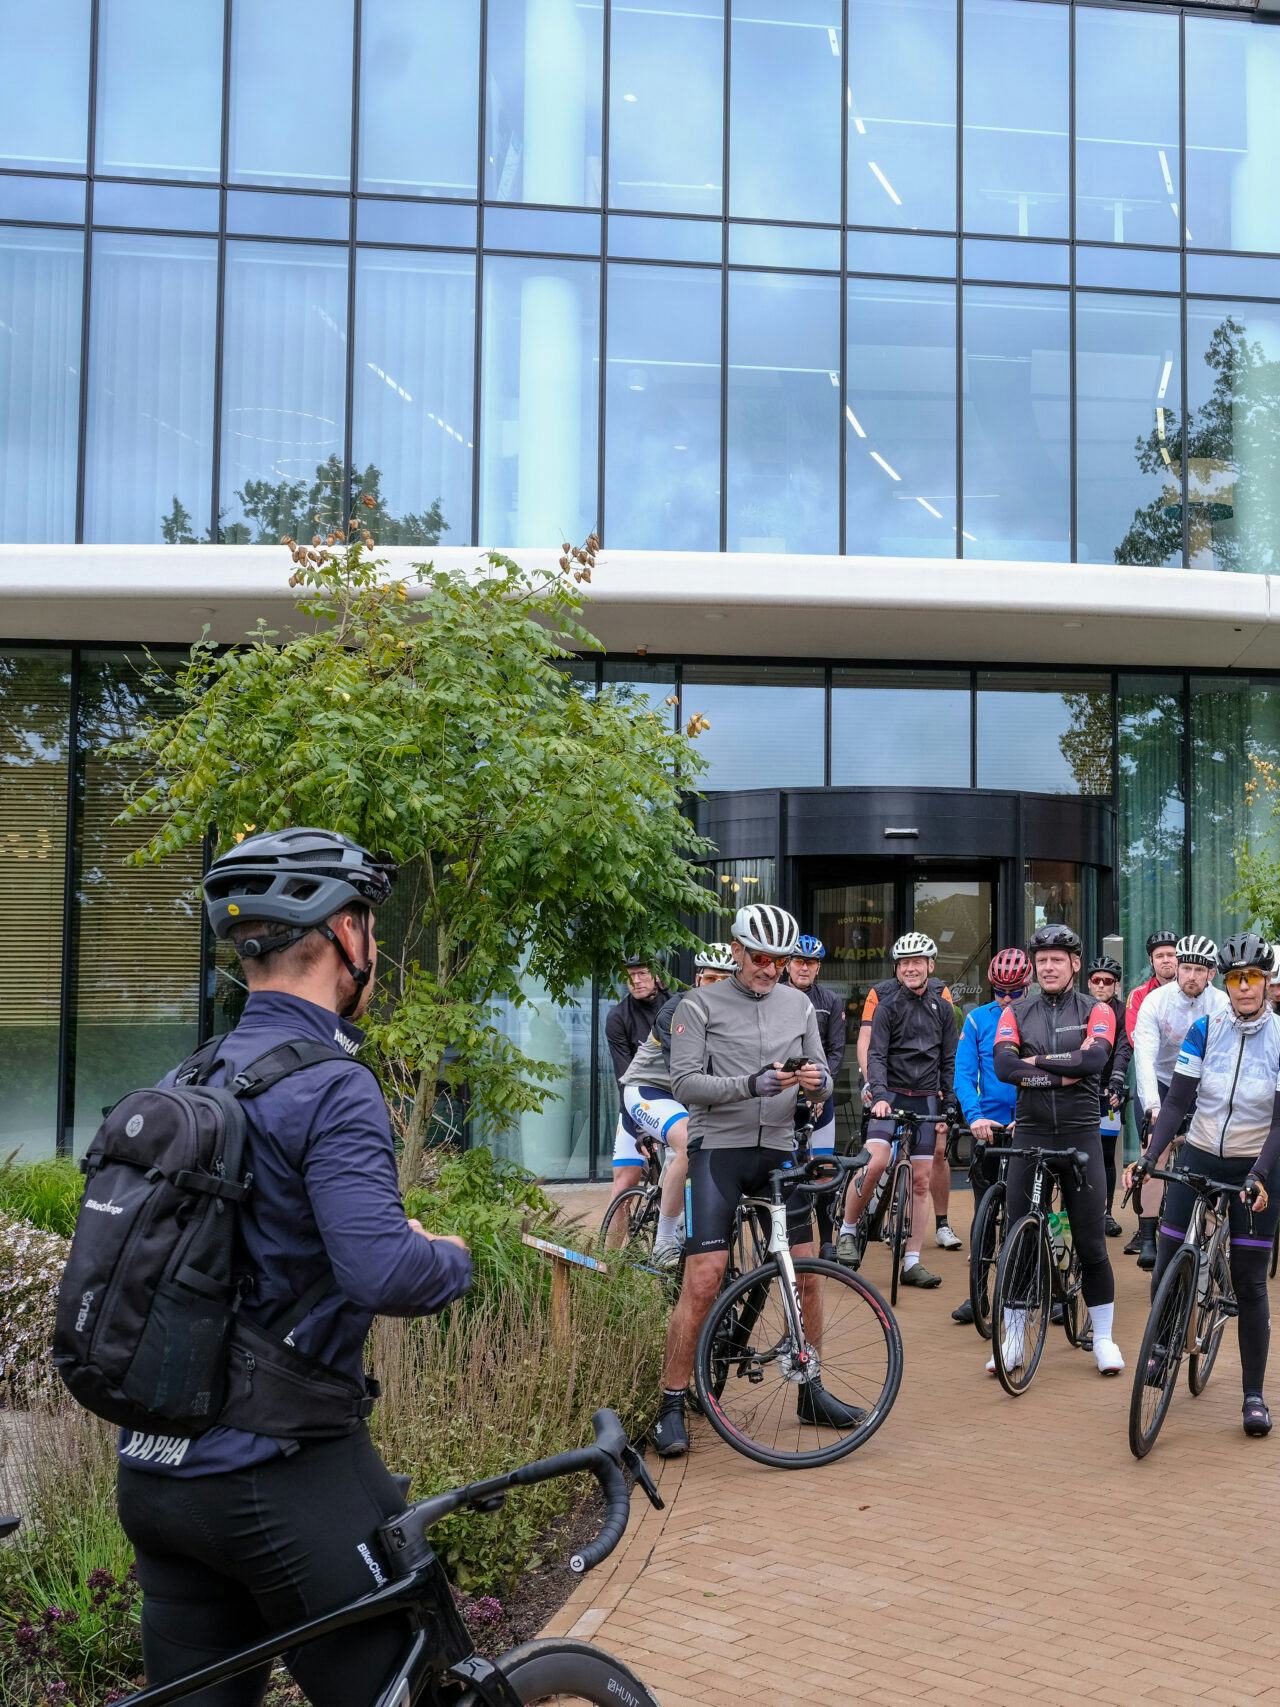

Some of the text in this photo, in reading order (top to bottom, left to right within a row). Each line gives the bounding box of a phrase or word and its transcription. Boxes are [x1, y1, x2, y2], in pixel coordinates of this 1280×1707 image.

[857, 916, 883, 924] HARRY
[834, 947, 886, 961] HAPPY
[953, 985, 983, 995] anwb
[120, 1430, 191, 1466] RAPHA
[614, 1684, 640, 1707] HUNT
